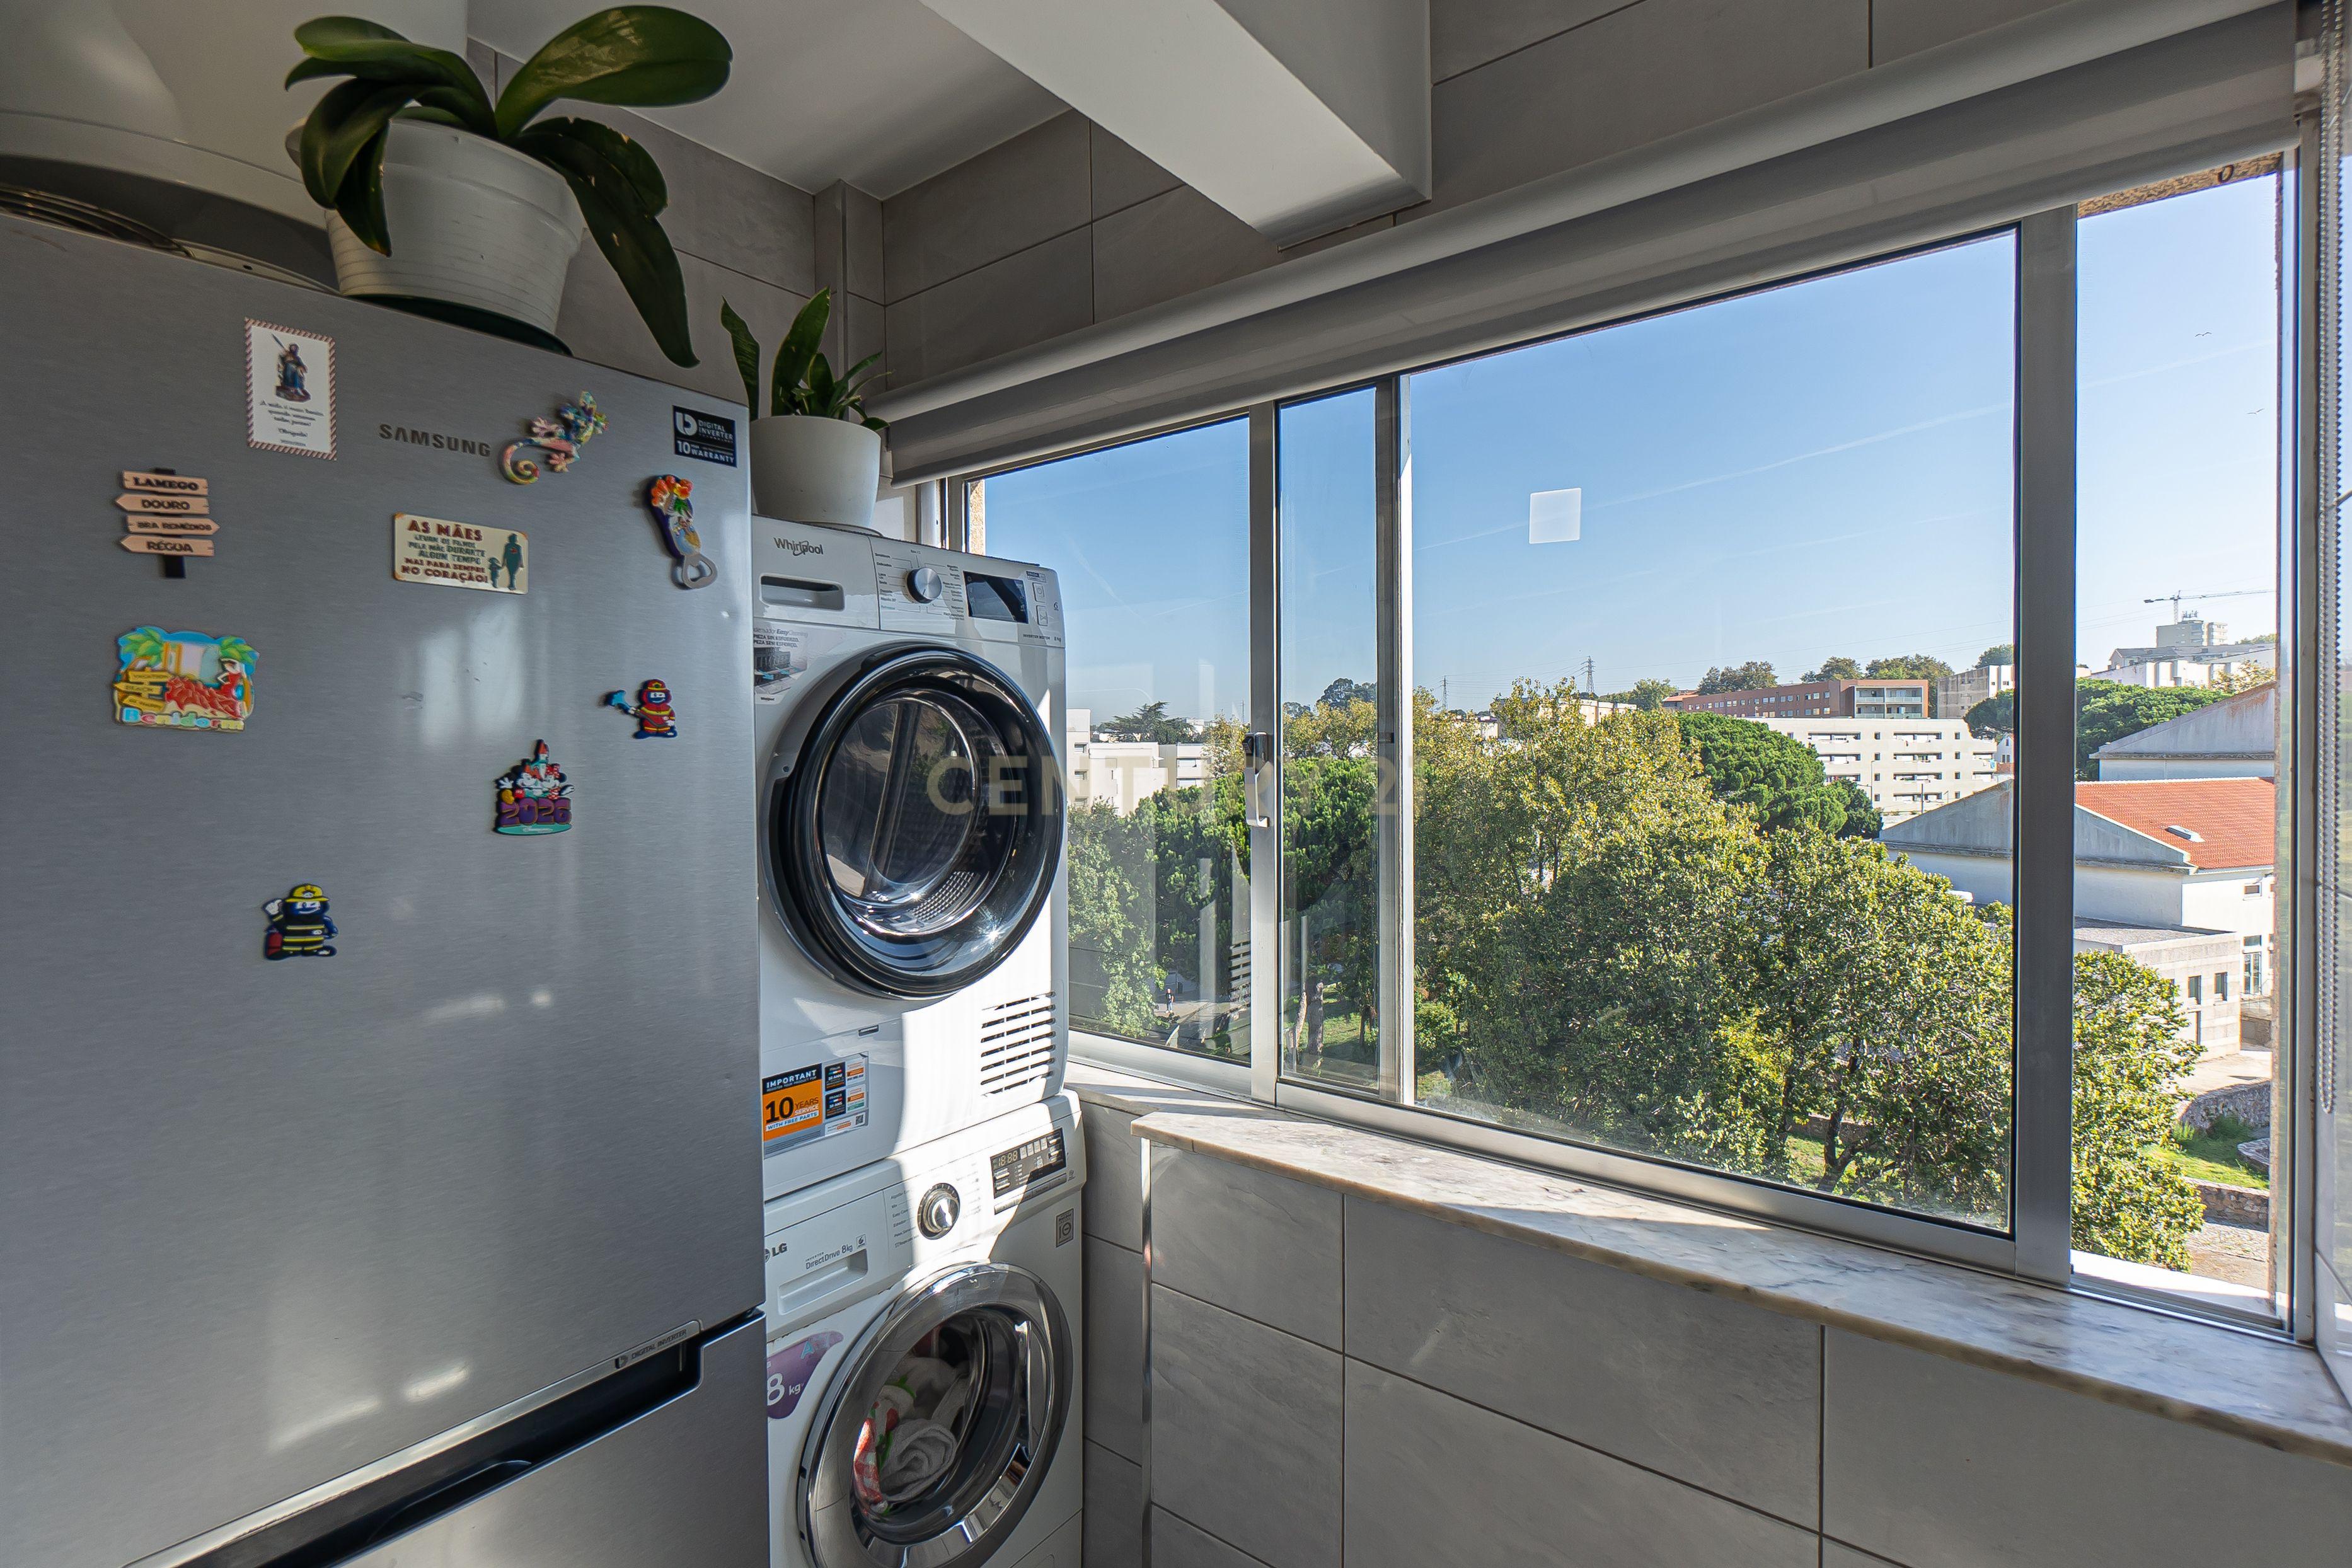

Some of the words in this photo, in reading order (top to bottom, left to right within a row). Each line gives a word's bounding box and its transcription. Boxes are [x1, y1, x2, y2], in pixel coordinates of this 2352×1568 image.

[698, 419, 725, 432] DIGITAL
[698, 427, 733, 440] INVERTER
[379, 424, 491, 457] SAMSUNG
[677, 440, 691, 454] 10
[691, 449, 734, 463] WARRANTY
[133, 476, 199, 491] LAMEGO
[141, 499, 190, 511] DOURO
[407, 519, 431, 534] AS
[435, 523, 483, 542] MÃES
[146, 540, 194, 553] RÉGUA
[447, 545, 486, 558] DURANTE
[773, 537, 824, 556] Whirlpool
[426, 560, 453, 569] PARA
[401, 565, 421, 576] NO
[424, 568, 489, 584] CORAÇÃO!
[122, 706, 245, 731] Benidorm
[499, 797, 572, 827] 2026
[766, 1069, 817, 1088] IMPORTANT
[766, 1097, 794, 1124] 10
[795, 1097, 819, 1109] YEARS
[767, 1122, 783, 1131] WITH
[799, 1111, 818, 1121] PARTS
[772, 1242, 788, 1257] LG
[631, 1343, 656, 1359] DIGITAL
[656, 1329, 687, 1347] INVERTER
[766, 1373, 785, 1406] 8
[788, 1383, 802, 1395] kg
